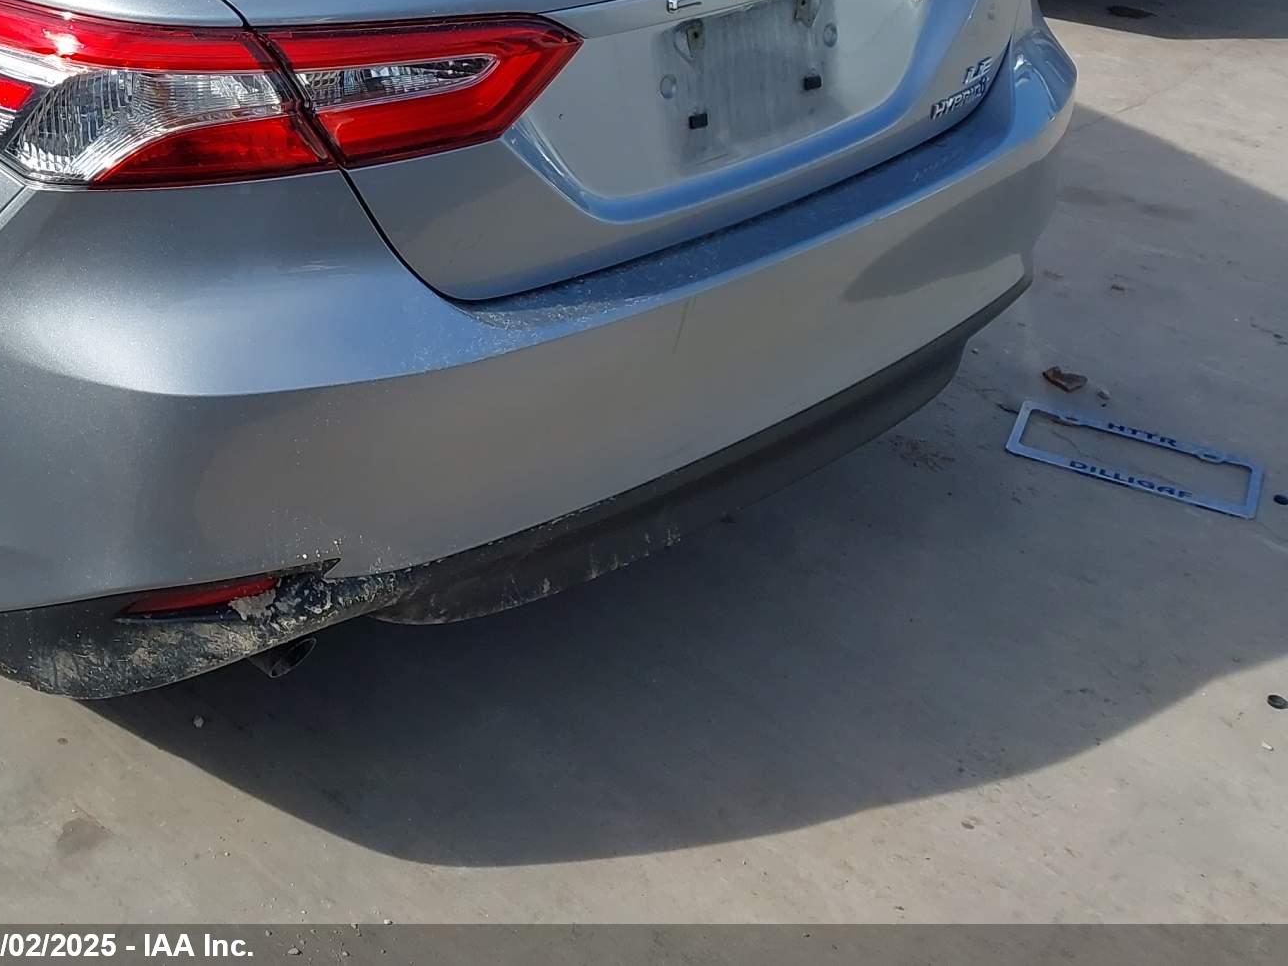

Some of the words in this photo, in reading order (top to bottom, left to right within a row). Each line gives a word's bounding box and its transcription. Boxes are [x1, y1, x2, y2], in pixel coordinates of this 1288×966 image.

[963, 56, 993, 84] LE
[1108, 422, 1178, 447] HTTR
[1070, 461, 1194, 498] DILLIGAF
